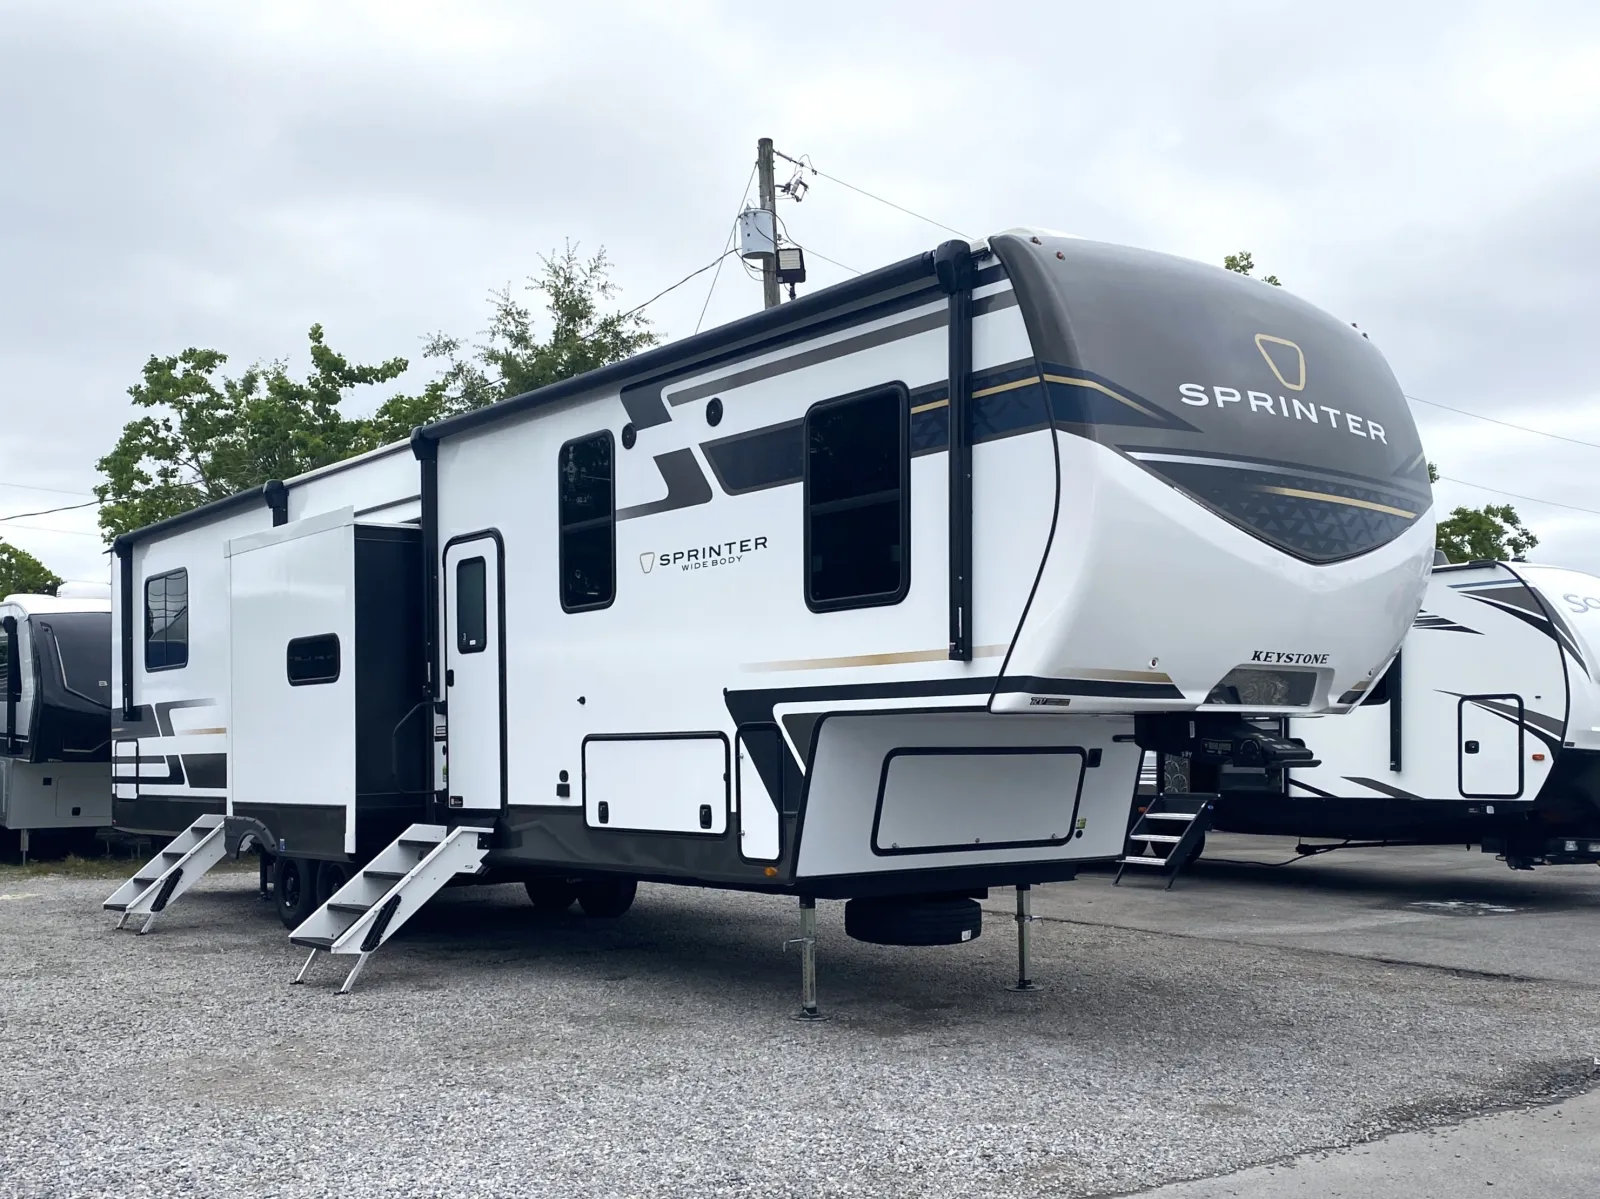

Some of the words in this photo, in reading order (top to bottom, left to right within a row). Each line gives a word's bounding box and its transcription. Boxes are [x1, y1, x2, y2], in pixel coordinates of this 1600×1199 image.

[1178, 383, 1388, 445] SPRINTER
[659, 536, 768, 566] SPRINTER
[681, 560, 709, 571] WIDE
[711, 554, 743, 567] BODY
[1251, 650, 1330, 664] KEYSTONE
